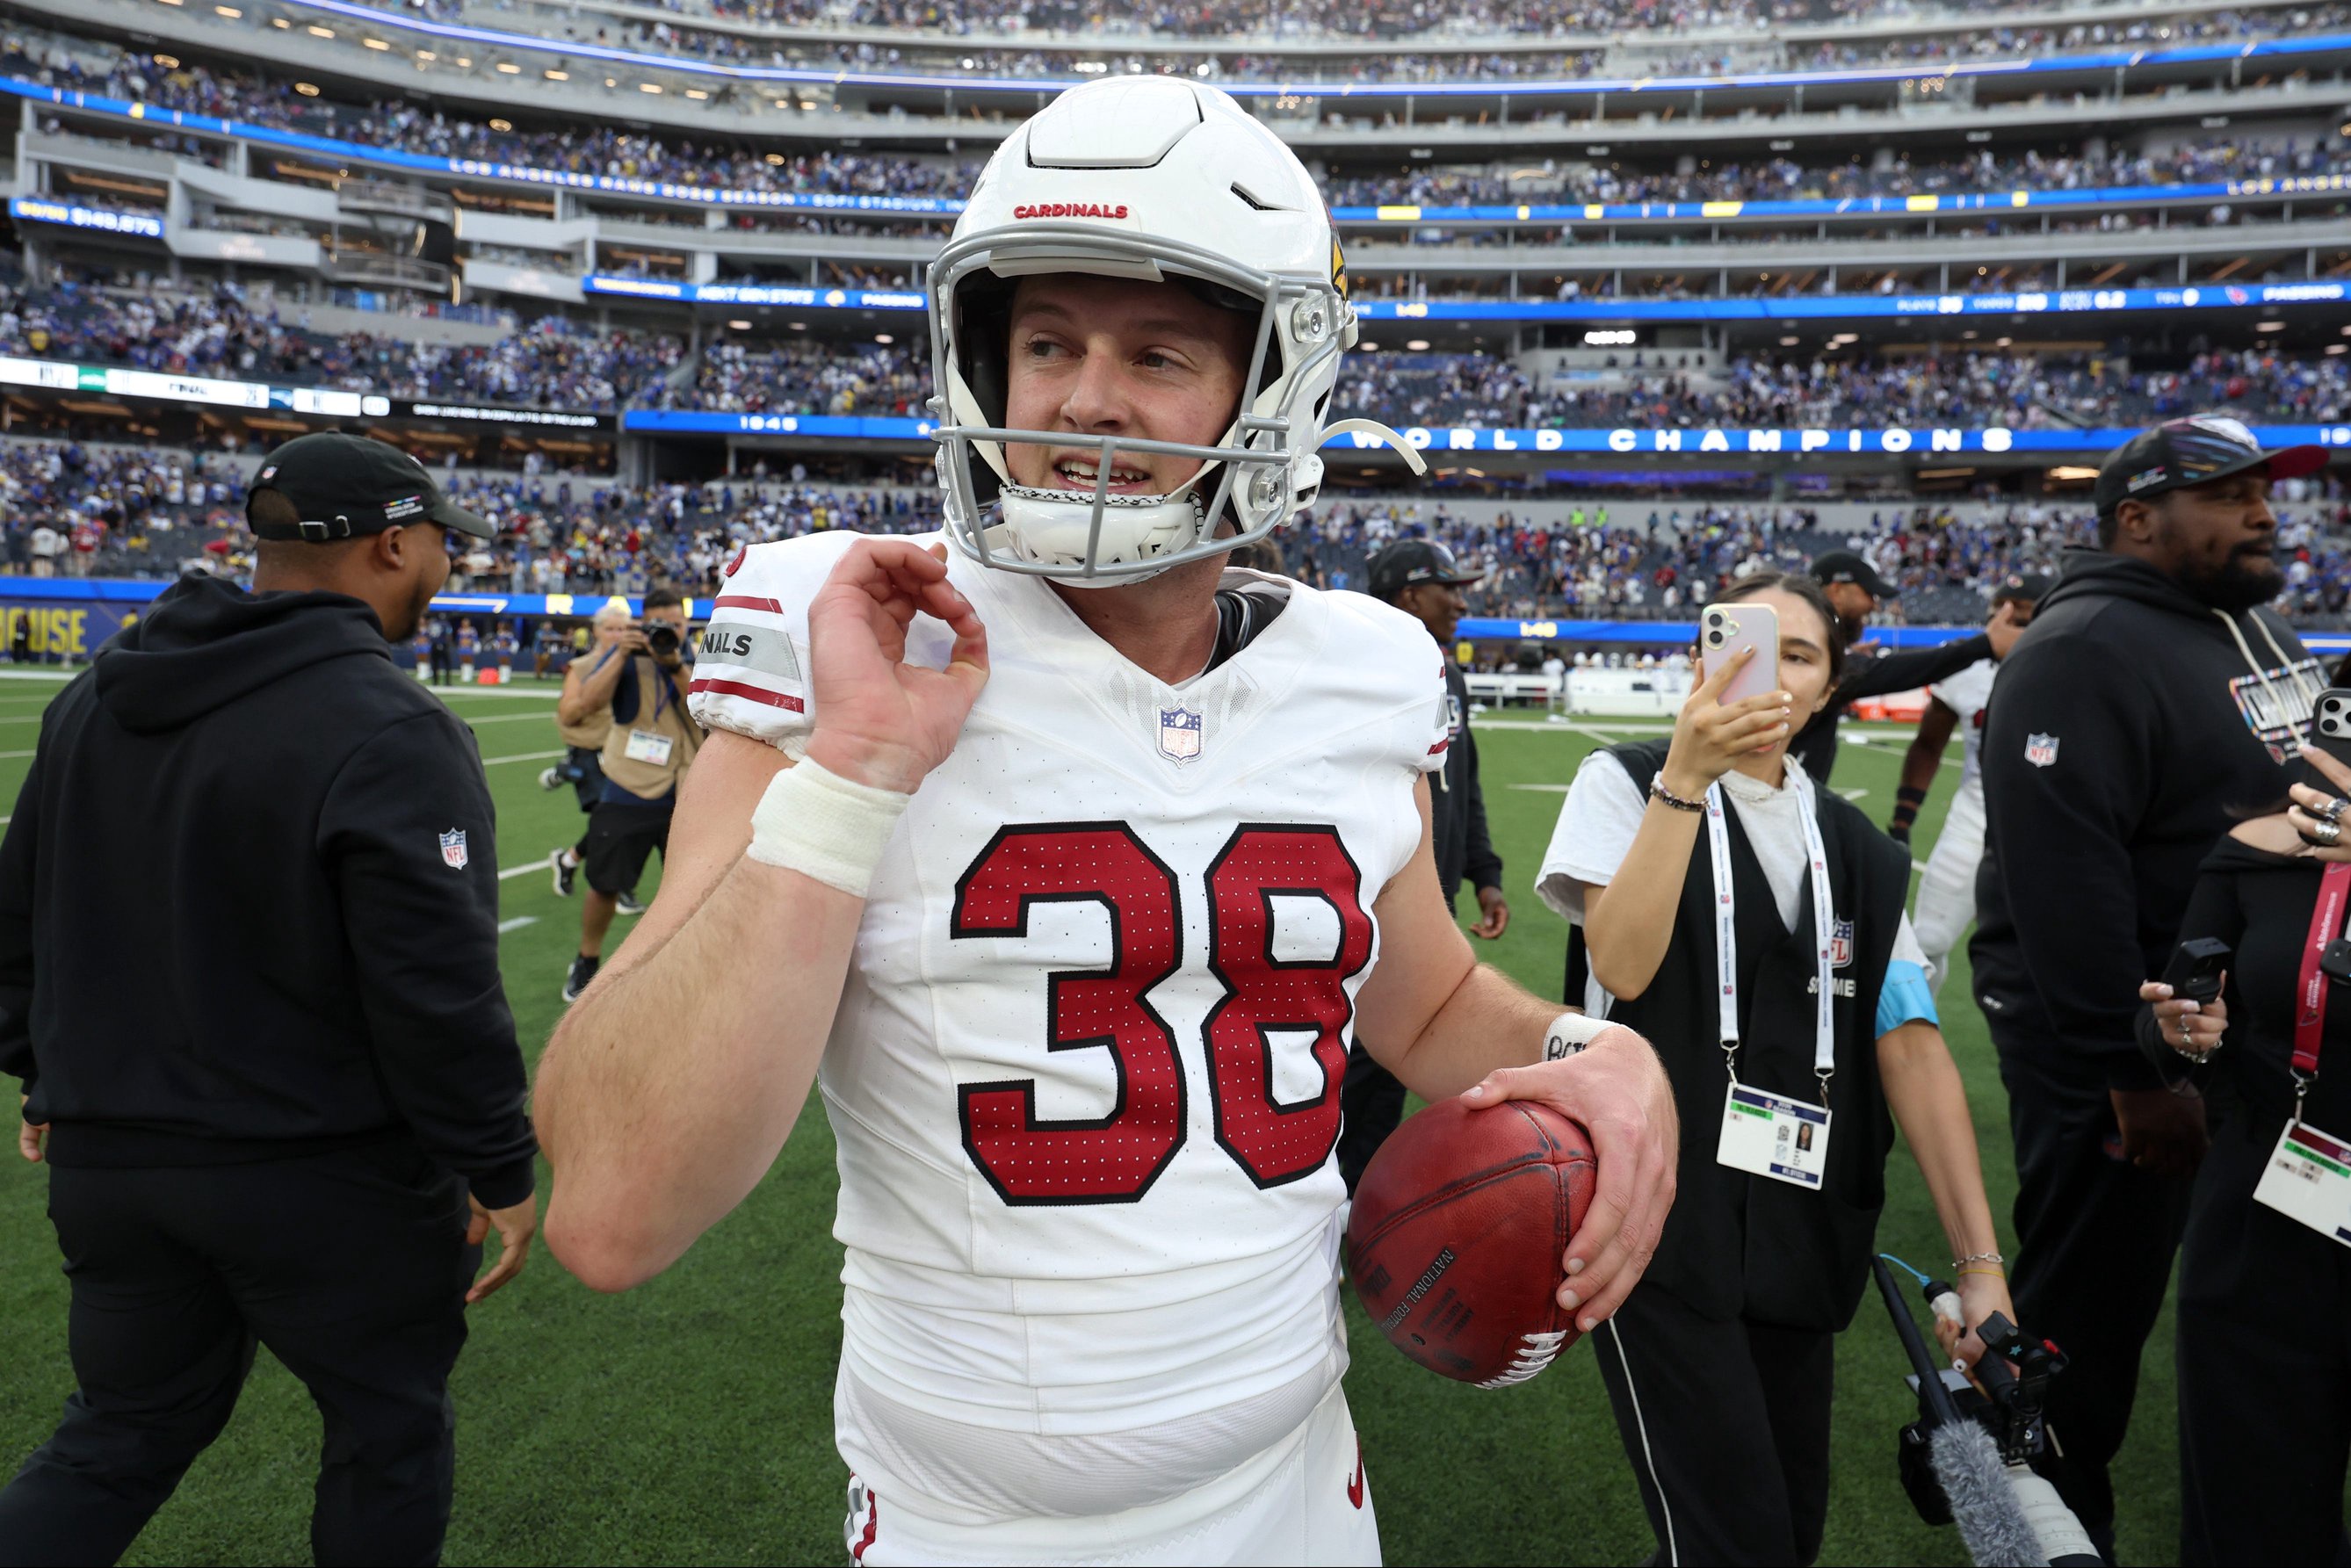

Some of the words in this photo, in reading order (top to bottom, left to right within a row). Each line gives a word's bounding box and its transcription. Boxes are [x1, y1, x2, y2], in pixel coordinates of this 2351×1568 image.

[449, 158, 492, 176] LOS
[497, 164, 595, 188] ANGELES
[599, 177, 657, 195] RAMS
[2227, 178, 2275, 196] LOS
[1014, 204, 1128, 219] CARDINALS
[1350, 428, 1563, 451] WORLD
[1608, 427, 2013, 452] CHAMPIONS
[445, 846, 465, 863] NFL
[950, 820, 1375, 1207] 38
[1406, 1248, 1456, 1305] NATIONAL
